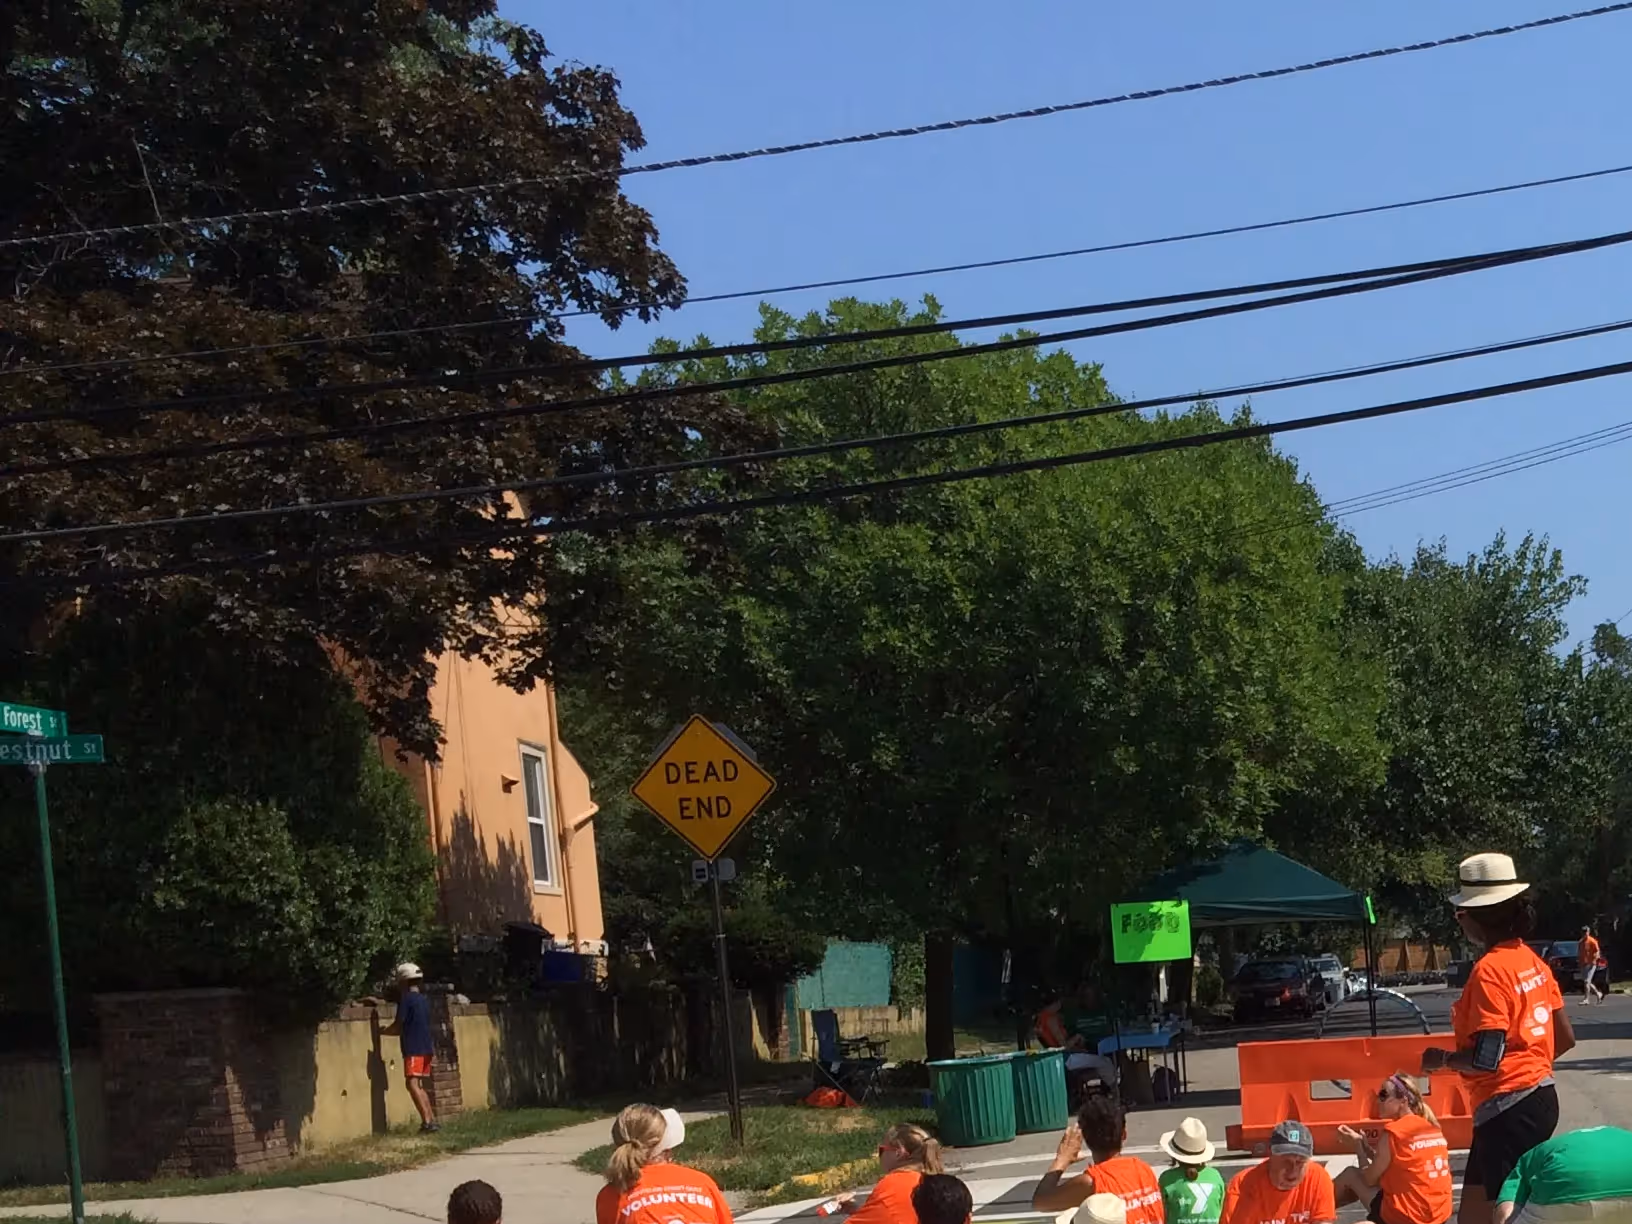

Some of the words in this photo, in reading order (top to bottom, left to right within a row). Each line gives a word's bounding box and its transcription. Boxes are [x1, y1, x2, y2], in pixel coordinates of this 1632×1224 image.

[3, 706, 42, 730] Forest
[84, 743, 97, 754] St
[665, 760, 738, 784] DEAD
[678, 796, 731, 820] END
